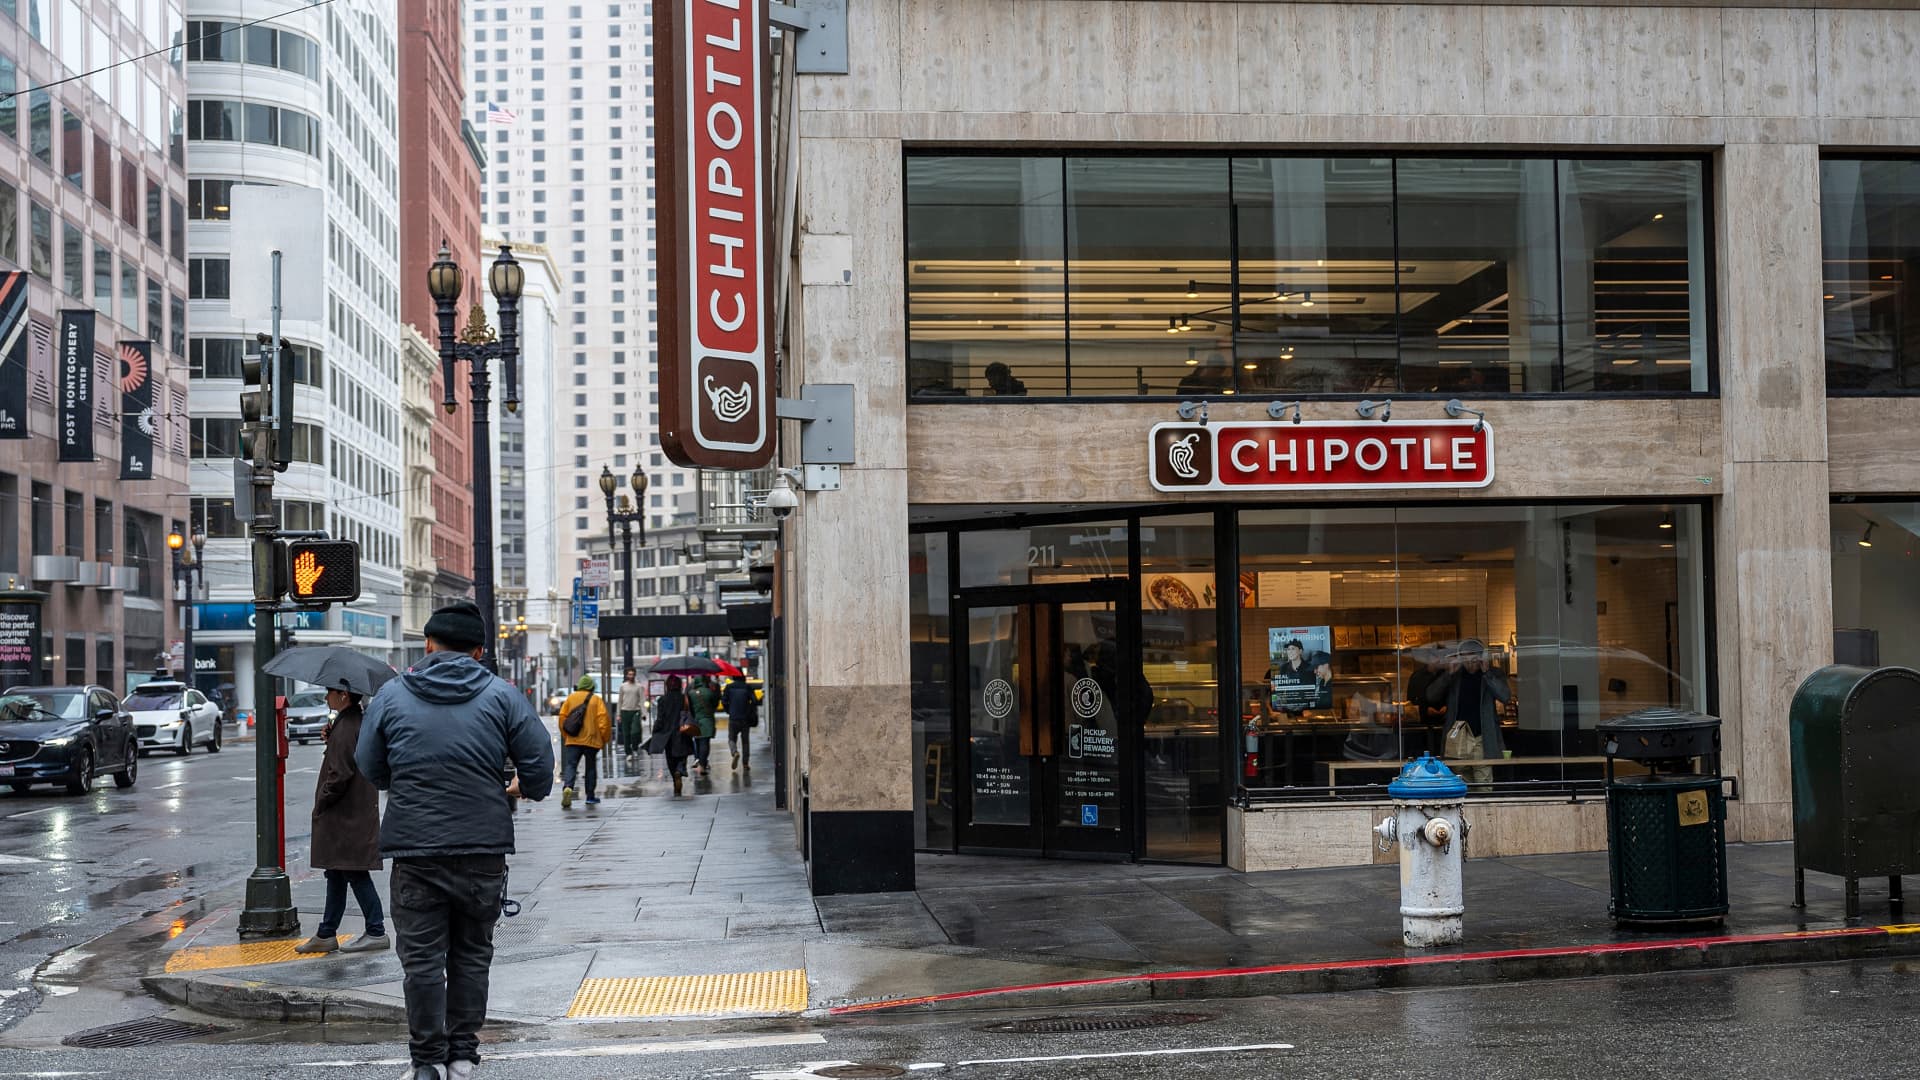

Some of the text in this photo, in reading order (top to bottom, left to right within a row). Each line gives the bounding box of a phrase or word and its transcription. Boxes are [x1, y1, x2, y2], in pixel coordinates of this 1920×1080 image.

[704, 0, 745, 331] CHIPOTL
[66, 323, 78, 445] POST MONTGOMERY
[1230, 437, 1477, 472] CHIPOTLE
[1028, 545, 1055, 567] 211
[0, 613, 29, 621] Discover
[0, 621, 35, 630] the perfect
[0, 630, 30, 638] payment
[0, 654, 19, 662] Apple
[195, 658, 216, 669] bank
[1083, 736, 1114, 745] DELIVERY
[1083, 744, 1115, 753] REWARDS
